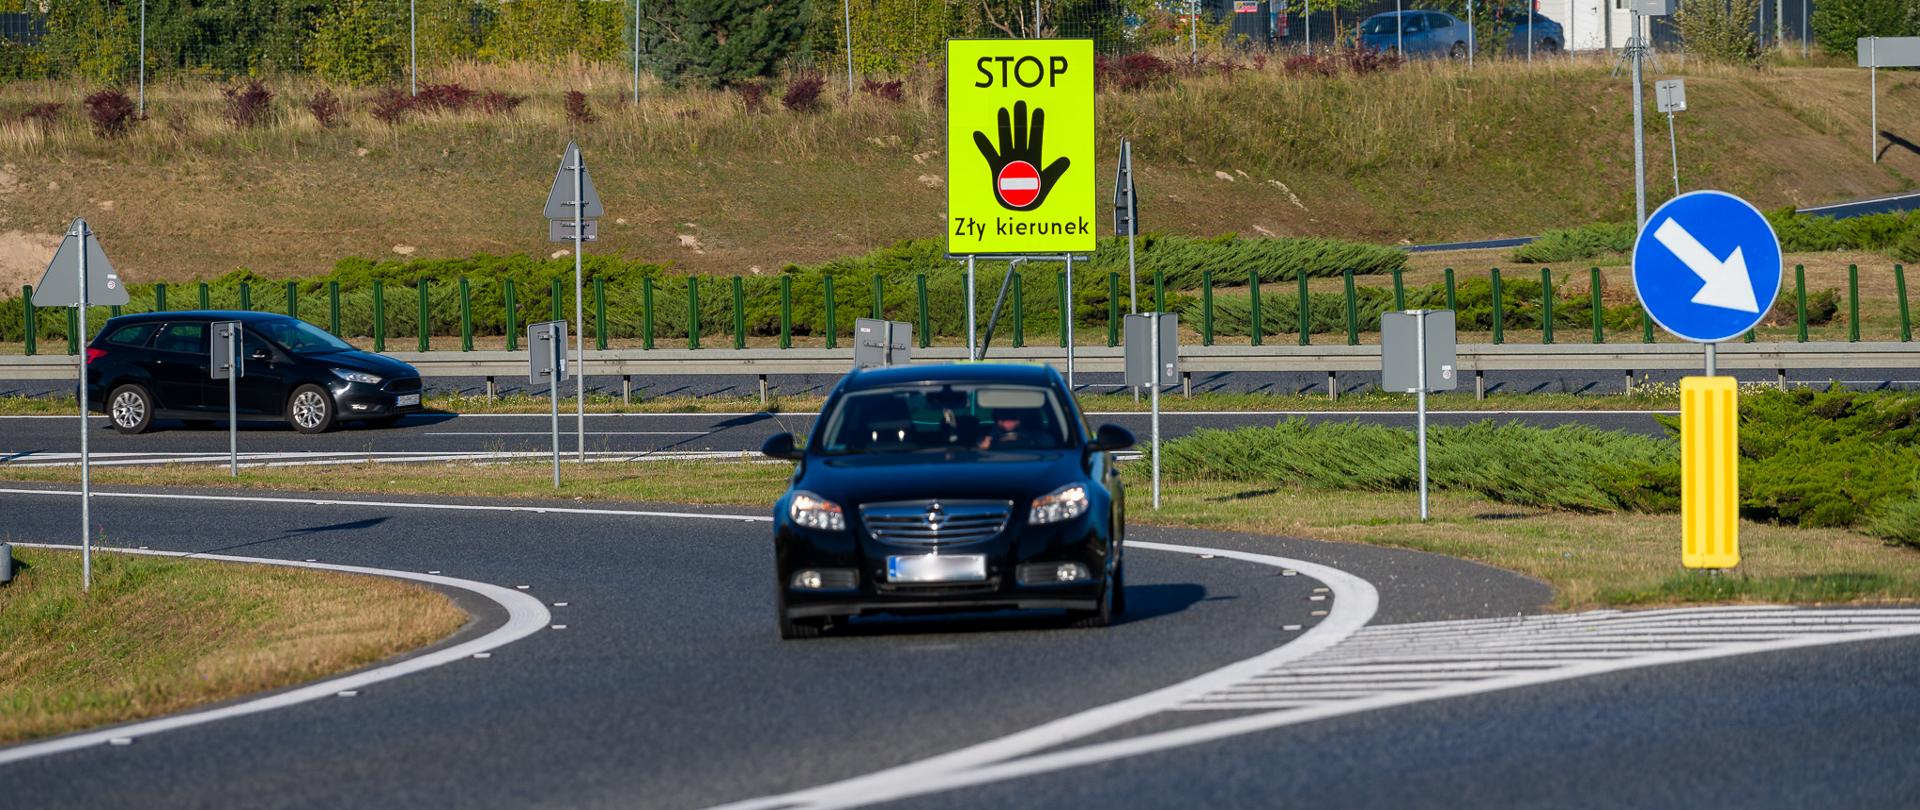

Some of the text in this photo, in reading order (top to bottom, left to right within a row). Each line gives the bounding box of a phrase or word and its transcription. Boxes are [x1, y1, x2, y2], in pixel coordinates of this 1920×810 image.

[975, 56, 1068, 88] STOP
[955, 216, 1089, 241] Zły kierunek
